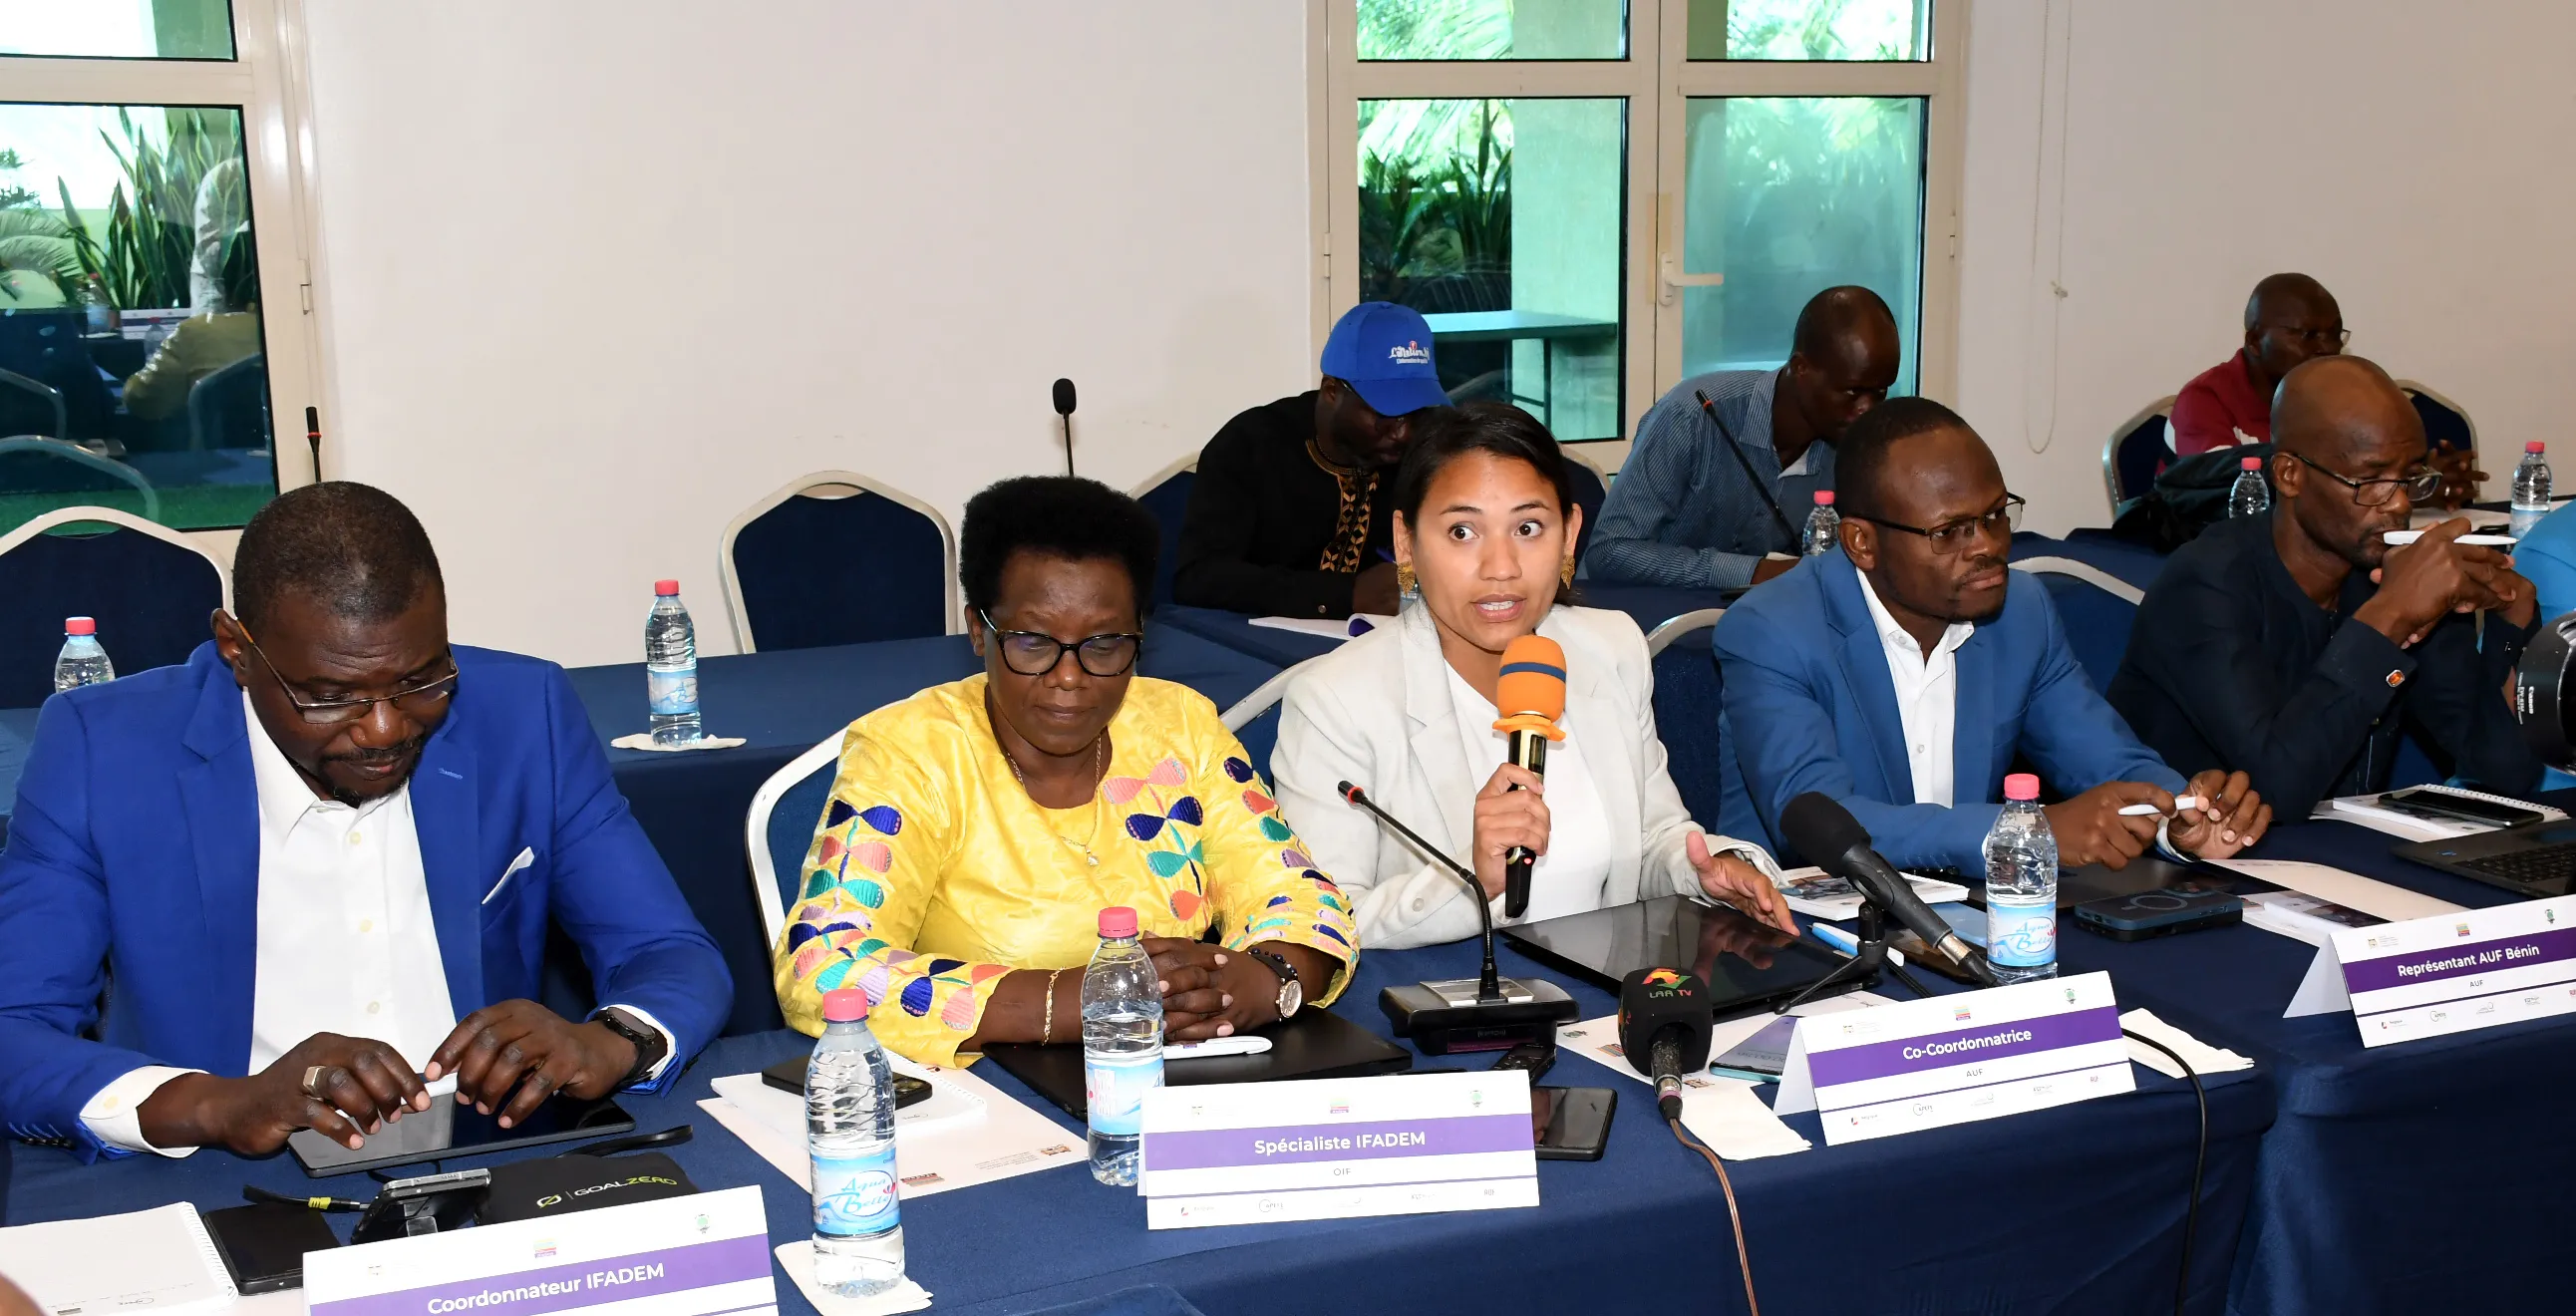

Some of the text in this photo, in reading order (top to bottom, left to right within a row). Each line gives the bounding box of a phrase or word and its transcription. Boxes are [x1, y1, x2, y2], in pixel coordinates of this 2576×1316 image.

[2398, 944, 2540, 977] Représentant AUF Bénin
[1902, 1029, 2033, 1060] Co-Coordonnatrice
[1966, 1068, 1984, 1078] AUF
[1254, 1132, 1426, 1156] Spécialiste IFADEM
[1333, 1167, 1352, 1177] OIF
[841, 1177, 886, 1191] Aqua
[842, 1192, 889, 1214] Belle
[428, 1262, 665, 1315] Coordonnateur IFADEM
